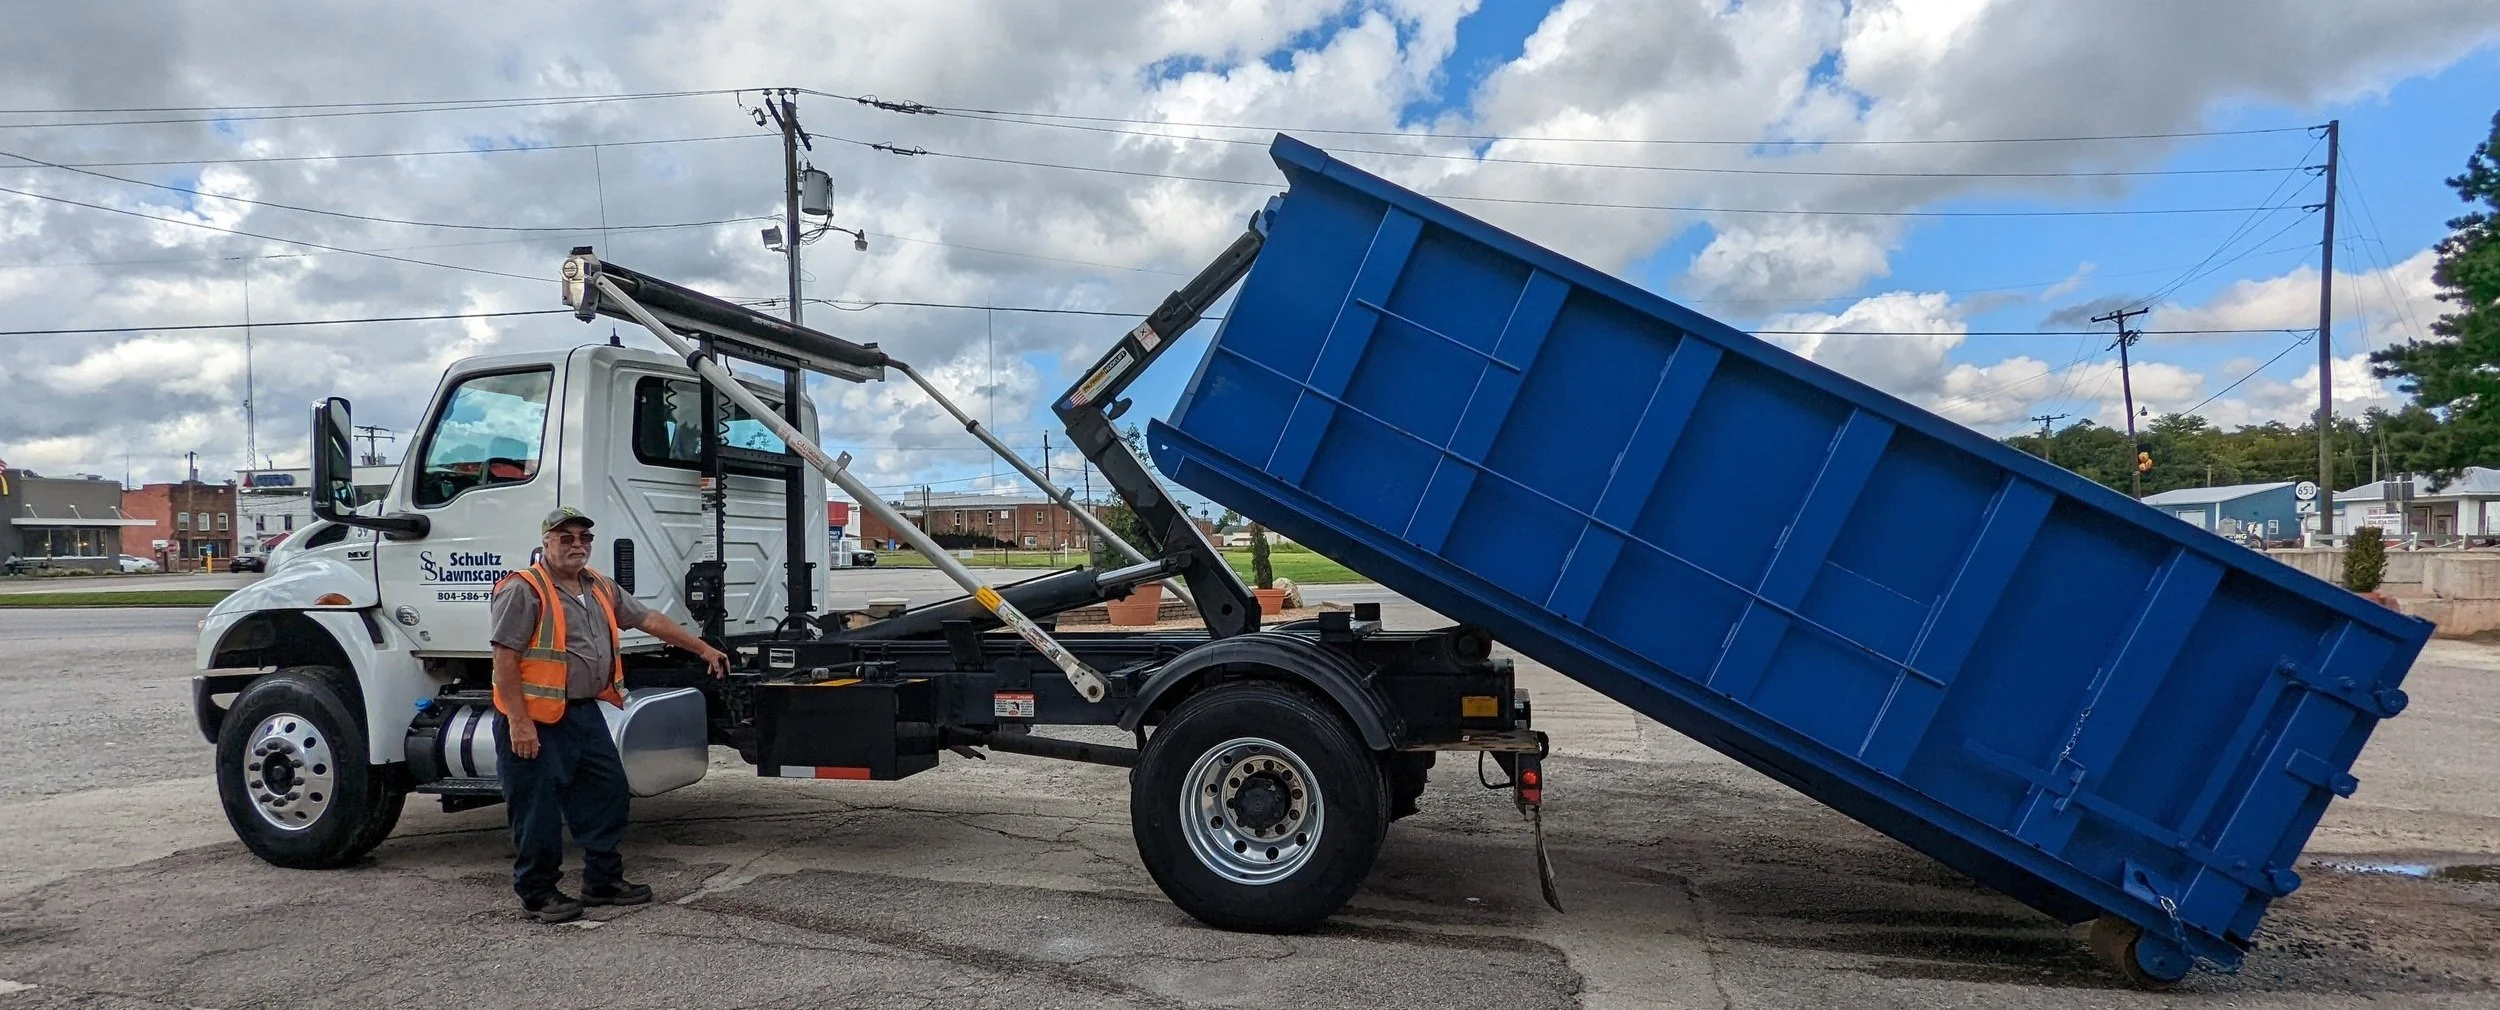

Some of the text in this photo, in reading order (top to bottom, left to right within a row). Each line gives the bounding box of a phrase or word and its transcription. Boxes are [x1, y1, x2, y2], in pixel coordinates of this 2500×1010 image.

[2298, 485, 2314, 495] 653
[450, 552, 501, 566] Schultz
[439, 567, 513, 584] Lawnscape
